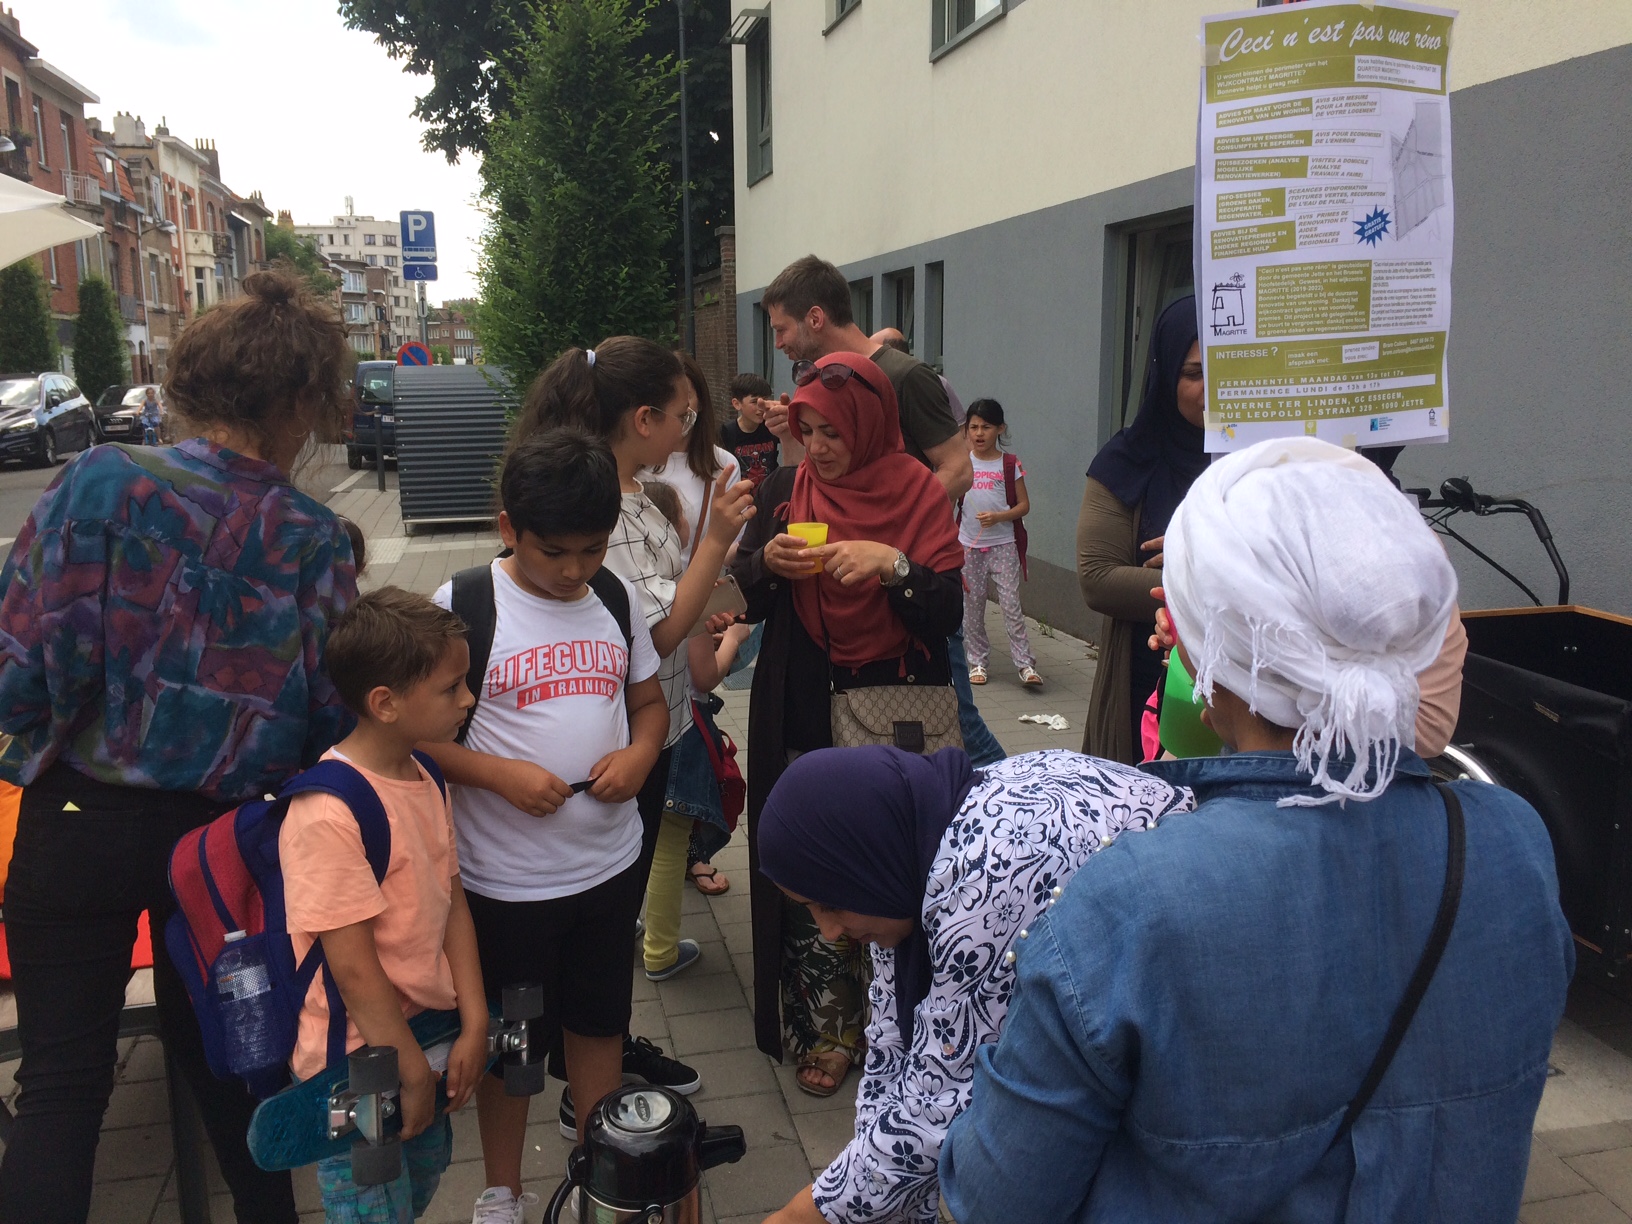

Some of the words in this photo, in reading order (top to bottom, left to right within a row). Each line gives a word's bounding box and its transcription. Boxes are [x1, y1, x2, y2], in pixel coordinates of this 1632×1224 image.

[1220, 27, 1275, 62] Ceci
[1349, 21, 1384, 48] pas
[1388, 29, 1410, 46] une
[1414, 24, 1441, 50] réno
[1217, 75, 1267, 88] WIJKCONTRACT
[1269, 70, 1306, 80] MAGRITTE?
[1223, 72, 1242, 80] woont
[1217, 87, 1245, 95] Bonnevie
[1246, 84, 1262, 92] helpt
[1331, 95, 1345, 103] SUR
[1218, 111, 1242, 120] ADVIES
[1254, 105, 1271, 114] MAAT
[1273, 103, 1292, 111] VOOR
[1315, 103, 1334, 111] POUR
[1347, 107, 1376, 115] LOGEMENT
[1218, 115, 1254, 126] RENOVATIE
[1282, 106, 1310, 116] WONING
[1216, 137, 1240, 145] ADVIES
[1241, 135, 1252, 143] OM
[1253, 134, 1264, 142] UW
[1349, 131, 1382, 139] ECONOMISER
[1216, 142, 1258, 152] CONSUMPTIE
[1269, 139, 1305, 147] BEPERKEN
[1217, 159, 1267, 167] HUISBEZOEKEN
[1268, 157, 1300, 165] (ANALYSE
[1216, 172, 1281, 180] RENOVATIEWERKEN)
[1218, 191, 1262, 201] INFO-SESSIES
[1288, 187, 1322, 195] SCEANCES
[1218, 205, 1262, 214] RECUPERATIE
[1316, 211, 1340, 220] PRIMES
[408, 214, 427, 242] P
[1297, 218, 1339, 228] RENOVATION
[1213, 230, 1236, 238] ADVIES
[1237, 228, 1248, 236] BIJ
[1298, 231, 1340, 240] FINANCIERES
[1213, 232, 1276, 245] RENOVATIEPREMIES
[1298, 238, 1339, 247] REGIONALES
[1213, 243, 1239, 252] ANDERE
[1240, 238, 1277, 248] REGIONALE
[1214, 247, 1251, 258] FINANCIELE
[1252, 245, 1270, 254] HULP
[1214, 327, 1248, 337] MAGRITTE
[1216, 348, 1268, 360] INTERESSE
[1270, 346, 1279, 358] ?
[1288, 352, 1305, 360] maak
[1288, 358, 1316, 367] afspraak
[1220, 377, 1295, 388] PERMANENTIE
[1300, 374, 1348, 384] MAANDAG
[1380, 370, 1390, 378] tot
[1220, 387, 1290, 397] PERMANENCE
[1296, 385, 1328, 394] LUNDI
[1347, 383, 1360, 391] 13h
[1369, 381, 1380, 390] 17h
[1219, 401, 1272, 411] TAVERNE
[1278, 400, 1301, 409] TER
[1307, 397, 1351, 407] LINDEN,
[1354, 396, 1365, 404] GC
[1220, 412, 1242, 420] RUE
[1247, 410, 1302, 419] LEOPOLD
[1308, 406, 1356, 417] I-STRAAT
[1381, 401, 1399, 410] 1090
[1401, 398, 1424, 409] JETTE
[972, 481, 994, 490] LOVE
[525, 688, 541, 705] IN
[549, 679, 614, 697] TRAINING
